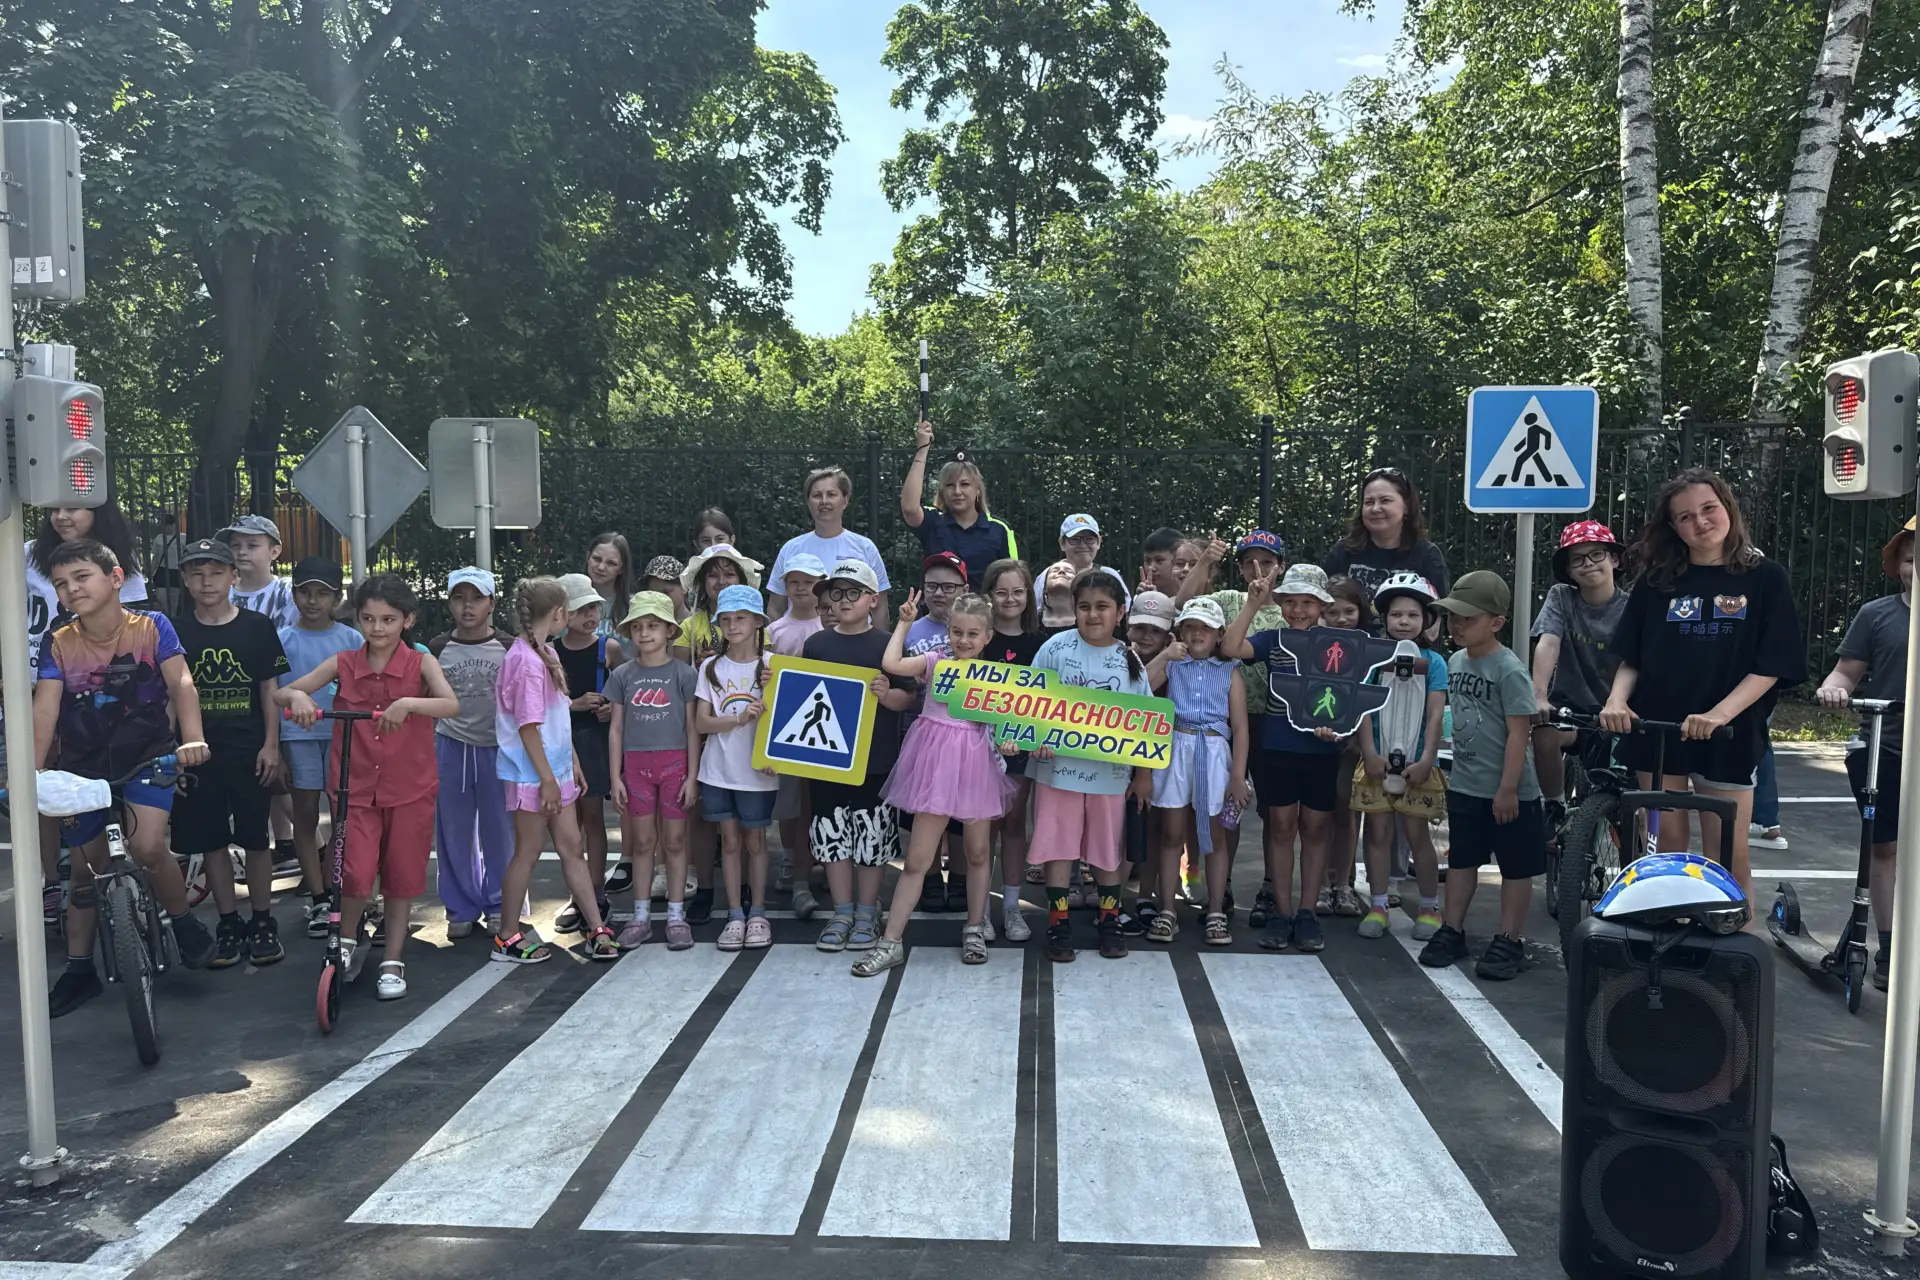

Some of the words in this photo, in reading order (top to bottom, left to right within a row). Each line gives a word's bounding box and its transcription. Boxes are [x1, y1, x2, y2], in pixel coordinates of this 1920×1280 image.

[40, 262, 47, 271] 2
[447, 659, 501, 676] DELIGHTE
[965, 663, 1009, 685] МЫ
[1015, 669, 1047, 689] ЗА
[196, 686, 251, 701] appa
[1448, 672, 1494, 700] PERFECT
[963, 687, 1171, 736] БЕЗОПАСНОСТЬ
[1001, 722, 1036, 743] НА
[1042, 728, 1168, 761] ДОРОГАХ
[333, 838, 344, 884] COSMO
